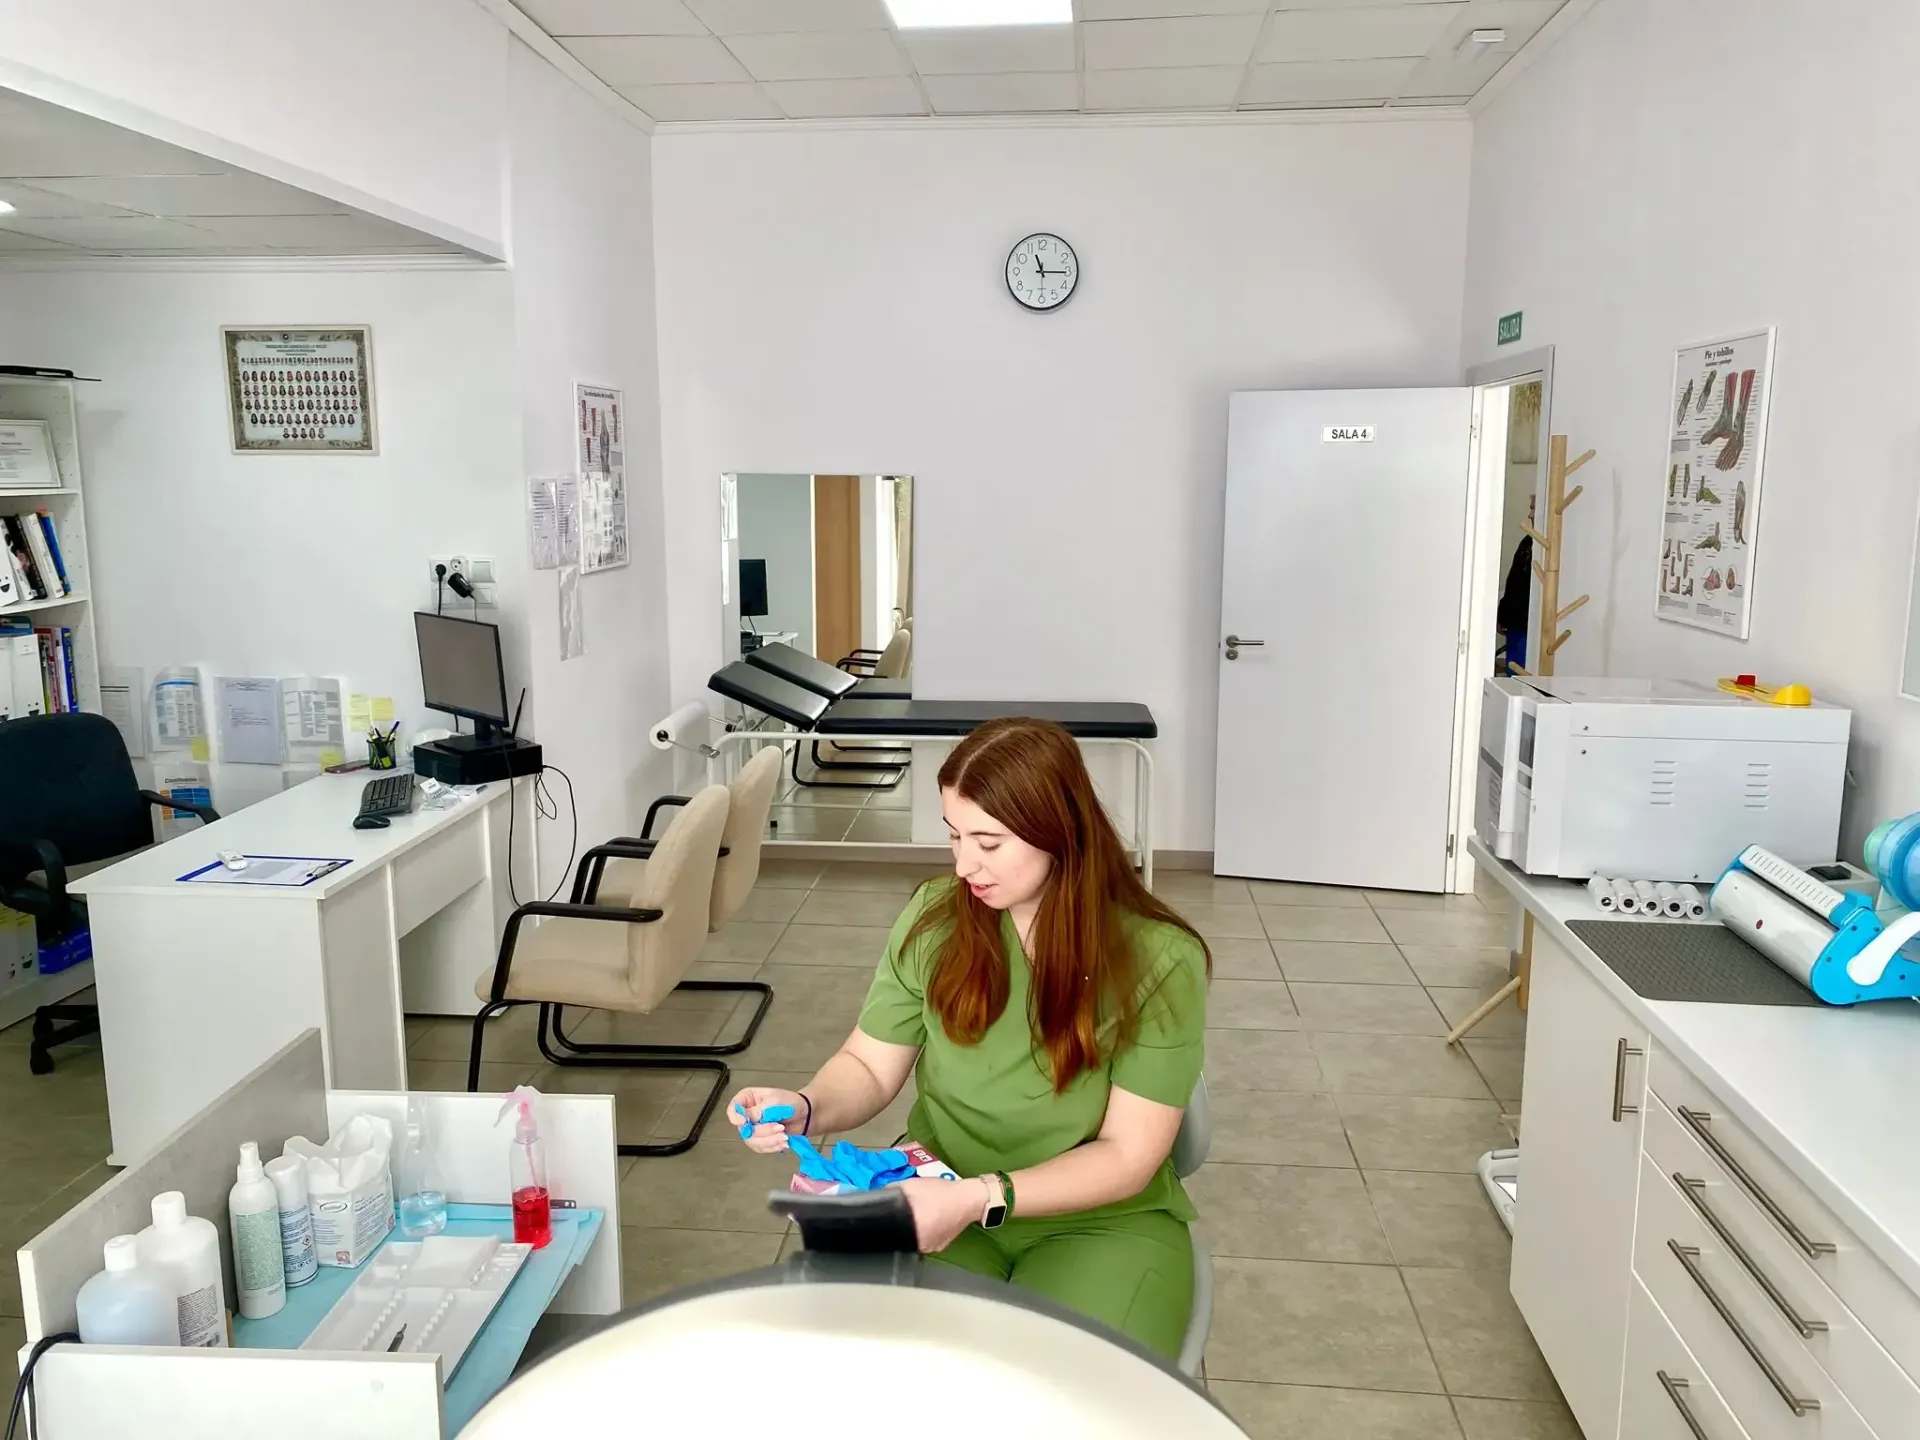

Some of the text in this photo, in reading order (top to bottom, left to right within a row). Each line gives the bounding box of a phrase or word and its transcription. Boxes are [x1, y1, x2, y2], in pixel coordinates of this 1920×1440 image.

[1027, 243, 1033, 254] 11
[1037, 239, 1047, 250] 12
[1016, 253, 1028, 264] 10
[1060, 252, 1068, 264] 2
[1012, 267, 1020, 277] 9
[1064, 266, 1072, 277] 3
[1016, 280, 1023, 291] 8
[1060, 280, 1067, 290] 4
[1026, 289, 1033, 300] 7
[1051, 289, 1058, 301] 5
[1331, 428, 1367, 440] SALA 4
